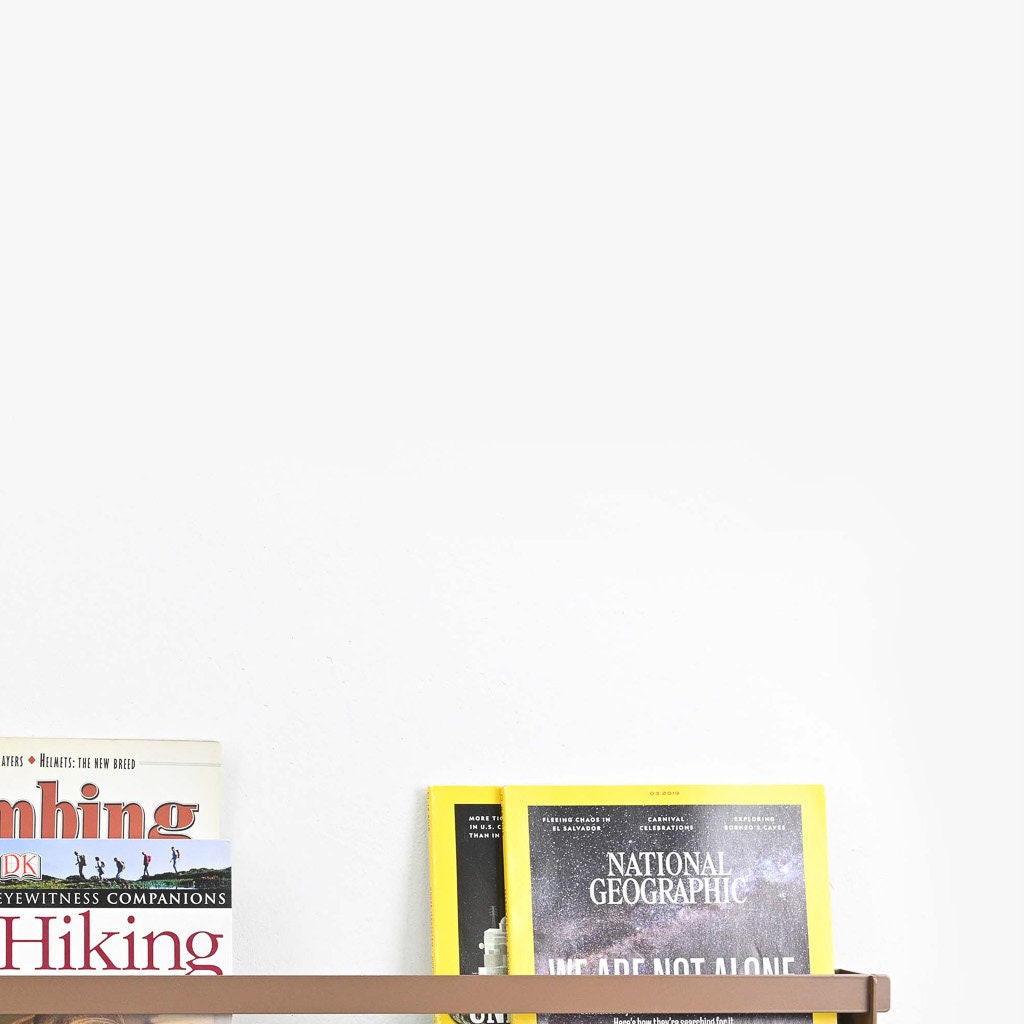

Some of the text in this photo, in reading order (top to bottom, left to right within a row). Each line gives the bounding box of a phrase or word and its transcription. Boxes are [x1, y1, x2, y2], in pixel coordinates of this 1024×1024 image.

[39, 753, 136, 770] HELMETS: THE NEW BREED
[4, 853, 37, 876] DK
[606, 851, 732, 876] NATIONAL
[107, 892, 227, 905] COMPANIONS
[588, 875, 749, 905] GEOGRAPHIC
